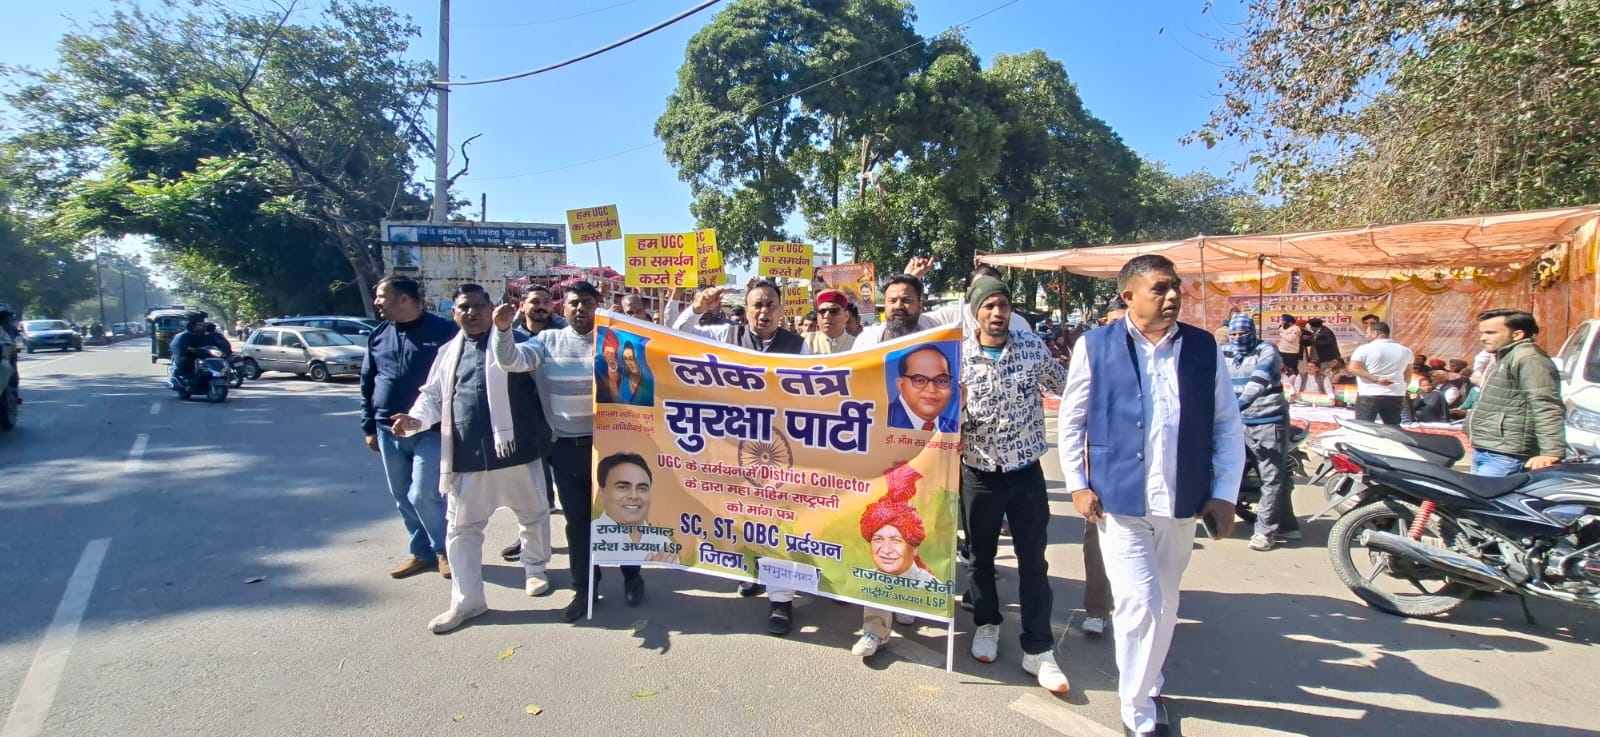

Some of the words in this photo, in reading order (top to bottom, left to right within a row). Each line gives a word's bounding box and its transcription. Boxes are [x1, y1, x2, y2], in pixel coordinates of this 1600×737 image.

[576, 210, 590, 220] हम
[592, 207, 608, 216] UGC
[572, 222, 584, 231] का
[587, 218, 616, 229] समर्थन
[478, 228, 500, 237] loving
[581, 232, 602, 241] करते
[637, 238, 658, 250] हम
[661, 235, 684, 249] UGC
[769, 245, 784, 253] हम
[786, 244, 803, 254] UGC
[629, 256, 646, 266] का
[652, 252, 693, 267] समर्थन
[778, 255, 810, 266] समर्थन
[640, 270, 670, 284] करते
[674, 269, 686, 285] हैं
[769, 267, 791, 276] करते
[794, 268, 803, 278] हैं
[787, 287, 801, 296] UGC
[669, 354, 765, 390] लोक
[776, 366, 850, 396] तंत्र
[664, 402, 775, 453] सुरक्षा
[785, 401, 874, 452] पार्टी
[885, 434, 896, 444] डॉ.
[898, 435, 912, 445] भीम
[658, 455, 681, 468] UGC
[685, 460, 697, 471] के
[746, 466, 758, 478] में
[761, 466, 806, 484] District
[811, 472, 870, 493] Collector
[685, 477, 697, 488] के
[701, 481, 723, 492] द्वारा
[727, 485, 750, 496] महा
[754, 487, 787, 501] महिम
[792, 493, 840, 508] राष्ट्रपती
[727, 500, 744, 513] को
[747, 504, 773, 517] मांग
[776, 510, 795, 520] पत्र
[596, 522, 632, 534] राजेश
[637, 523, 675, 537] पांचाल
[681, 513, 708, 538] SC,
[714, 517, 736, 544] ST,
[744, 521, 779, 547] OBC
[622, 542, 660, 553] अध्यक्ष
[663, 542, 682, 554] LSP
[699, 542, 748, 570] जिला,
[851, 567, 922, 590] राजकुमार
[924, 578, 954, 595] सैनी
[861, 586, 889, 598] राष्ट्रीय
[892, 592, 923, 604] अध्यक्ष
[926, 596, 945, 608] LSP
